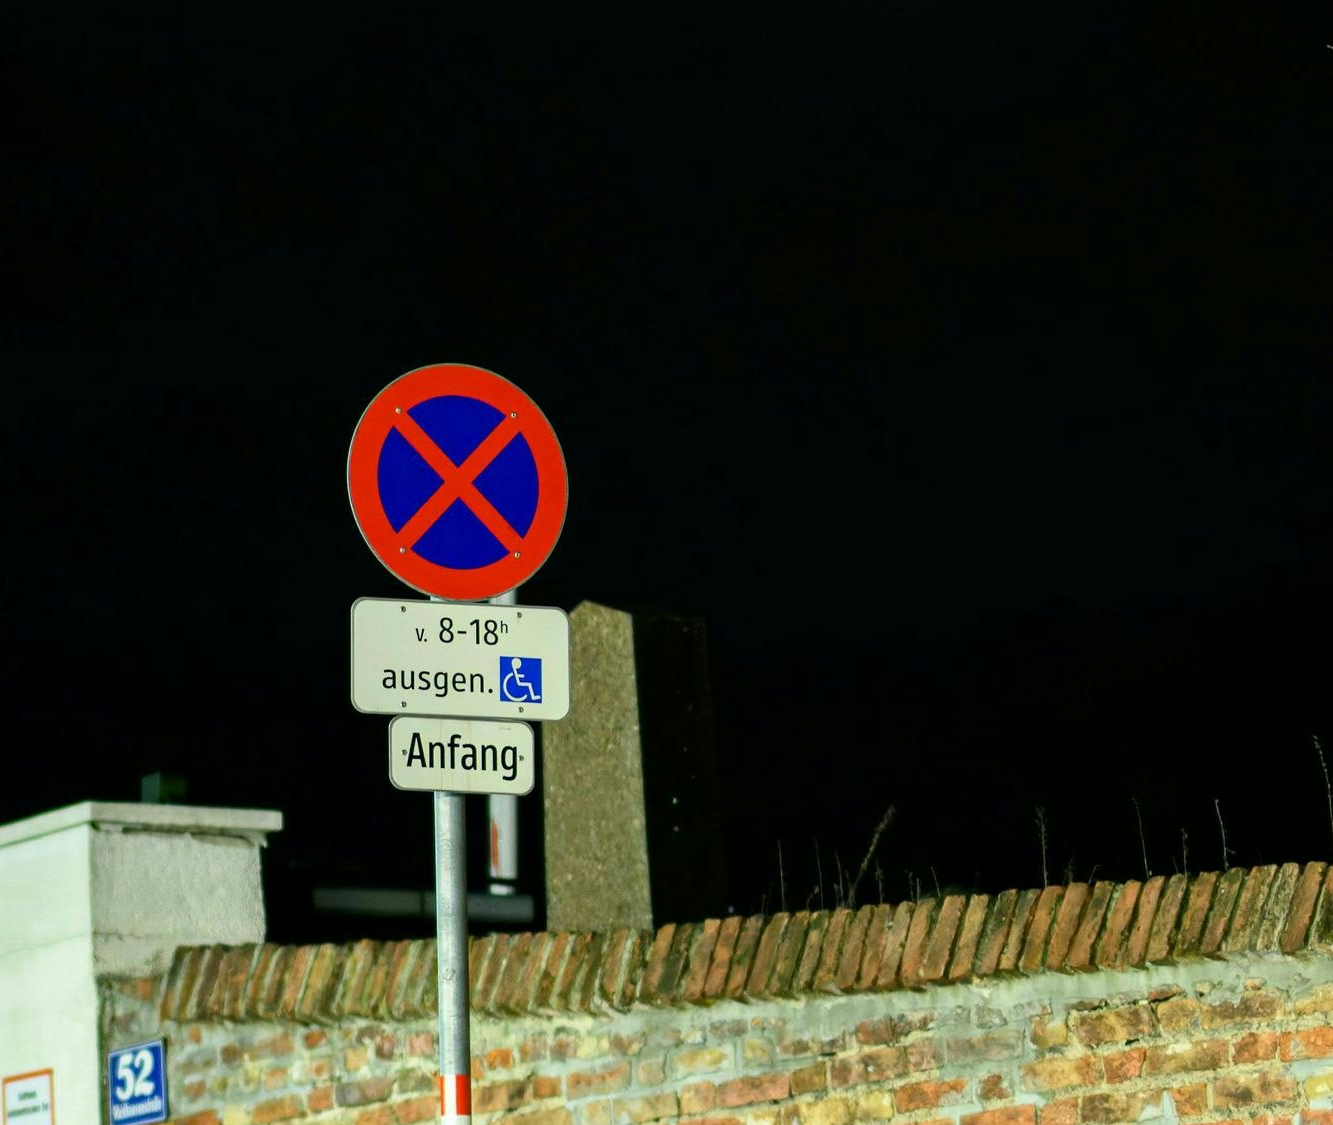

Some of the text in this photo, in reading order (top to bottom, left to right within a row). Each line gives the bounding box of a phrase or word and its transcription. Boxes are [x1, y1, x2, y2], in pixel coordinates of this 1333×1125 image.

[415, 628, 428, 643] v.
[381, 668, 494, 698] ausgen.
[406, 731, 518, 781] Anfang
[115, 1048, 156, 1103] 52
